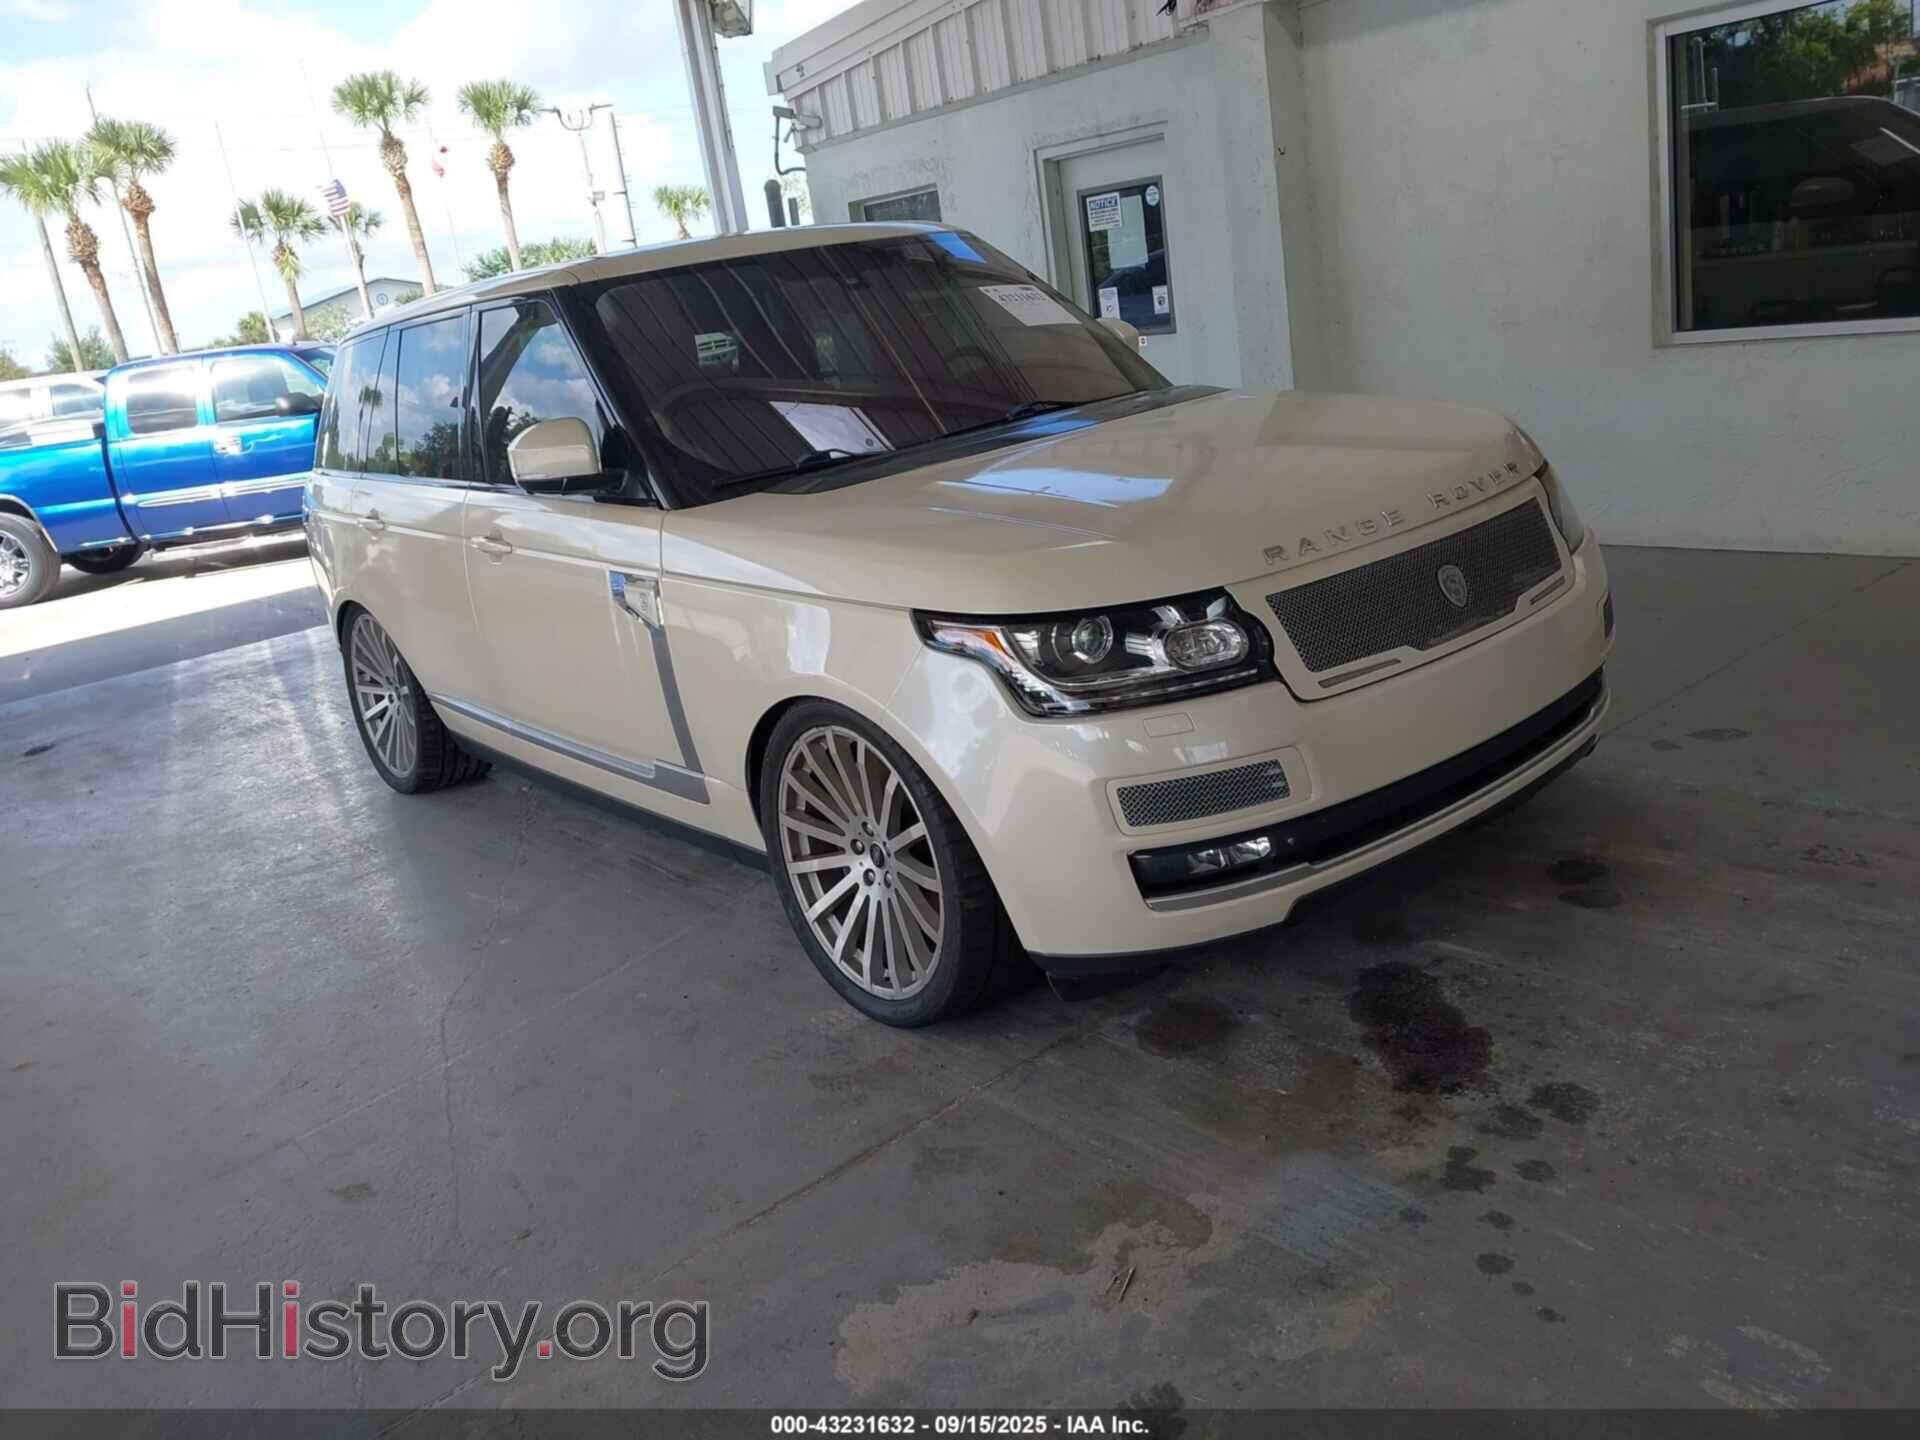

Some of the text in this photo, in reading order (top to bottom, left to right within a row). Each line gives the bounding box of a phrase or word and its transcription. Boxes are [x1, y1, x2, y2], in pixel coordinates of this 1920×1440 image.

[1089, 197, 1117, 209] NOTICE
[1262, 462, 1520, 565] RANGE ROVER
